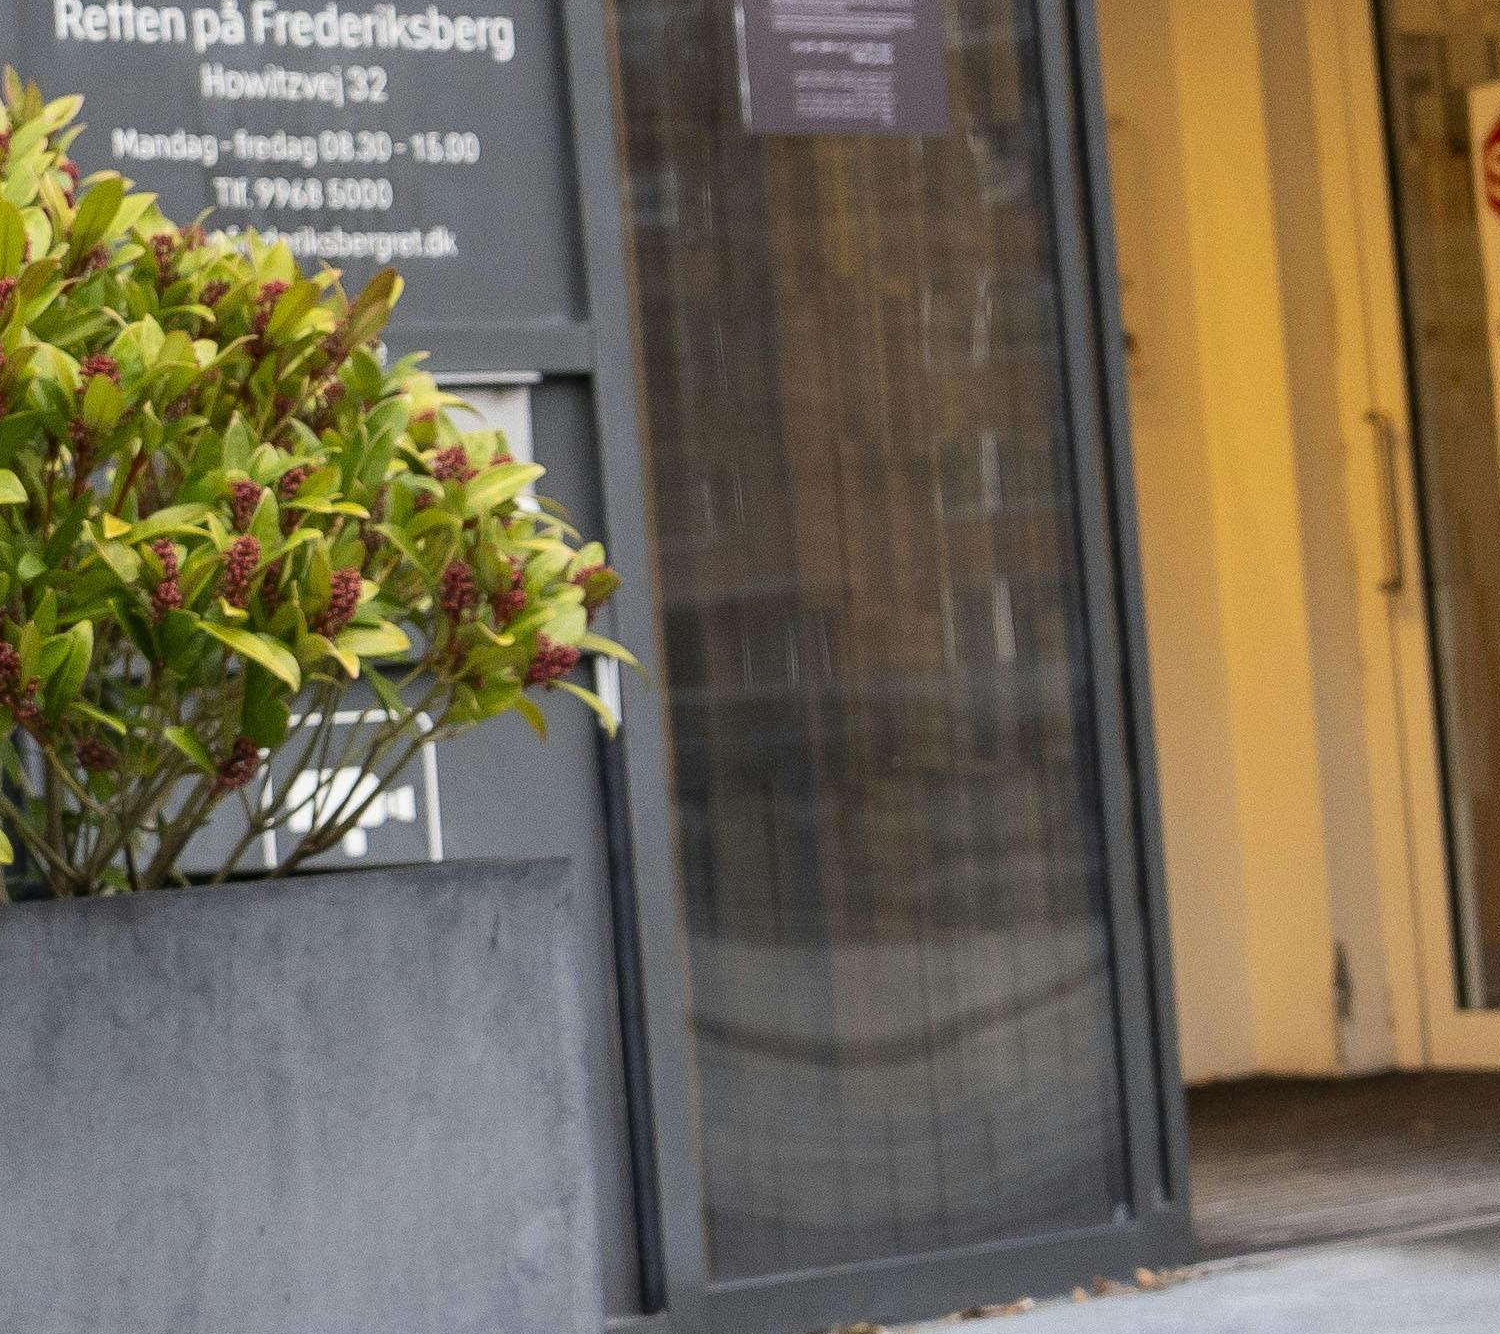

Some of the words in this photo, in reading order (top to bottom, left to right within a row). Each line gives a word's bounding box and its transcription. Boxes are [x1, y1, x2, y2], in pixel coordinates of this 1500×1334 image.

[199, 62, 346, 109] Howitzvej
[344, 65, 390, 104] 32
[111, 127, 220, 167] Mandag
[233, 128, 318, 168] fredag
[325, 177, 394, 211] 5000
